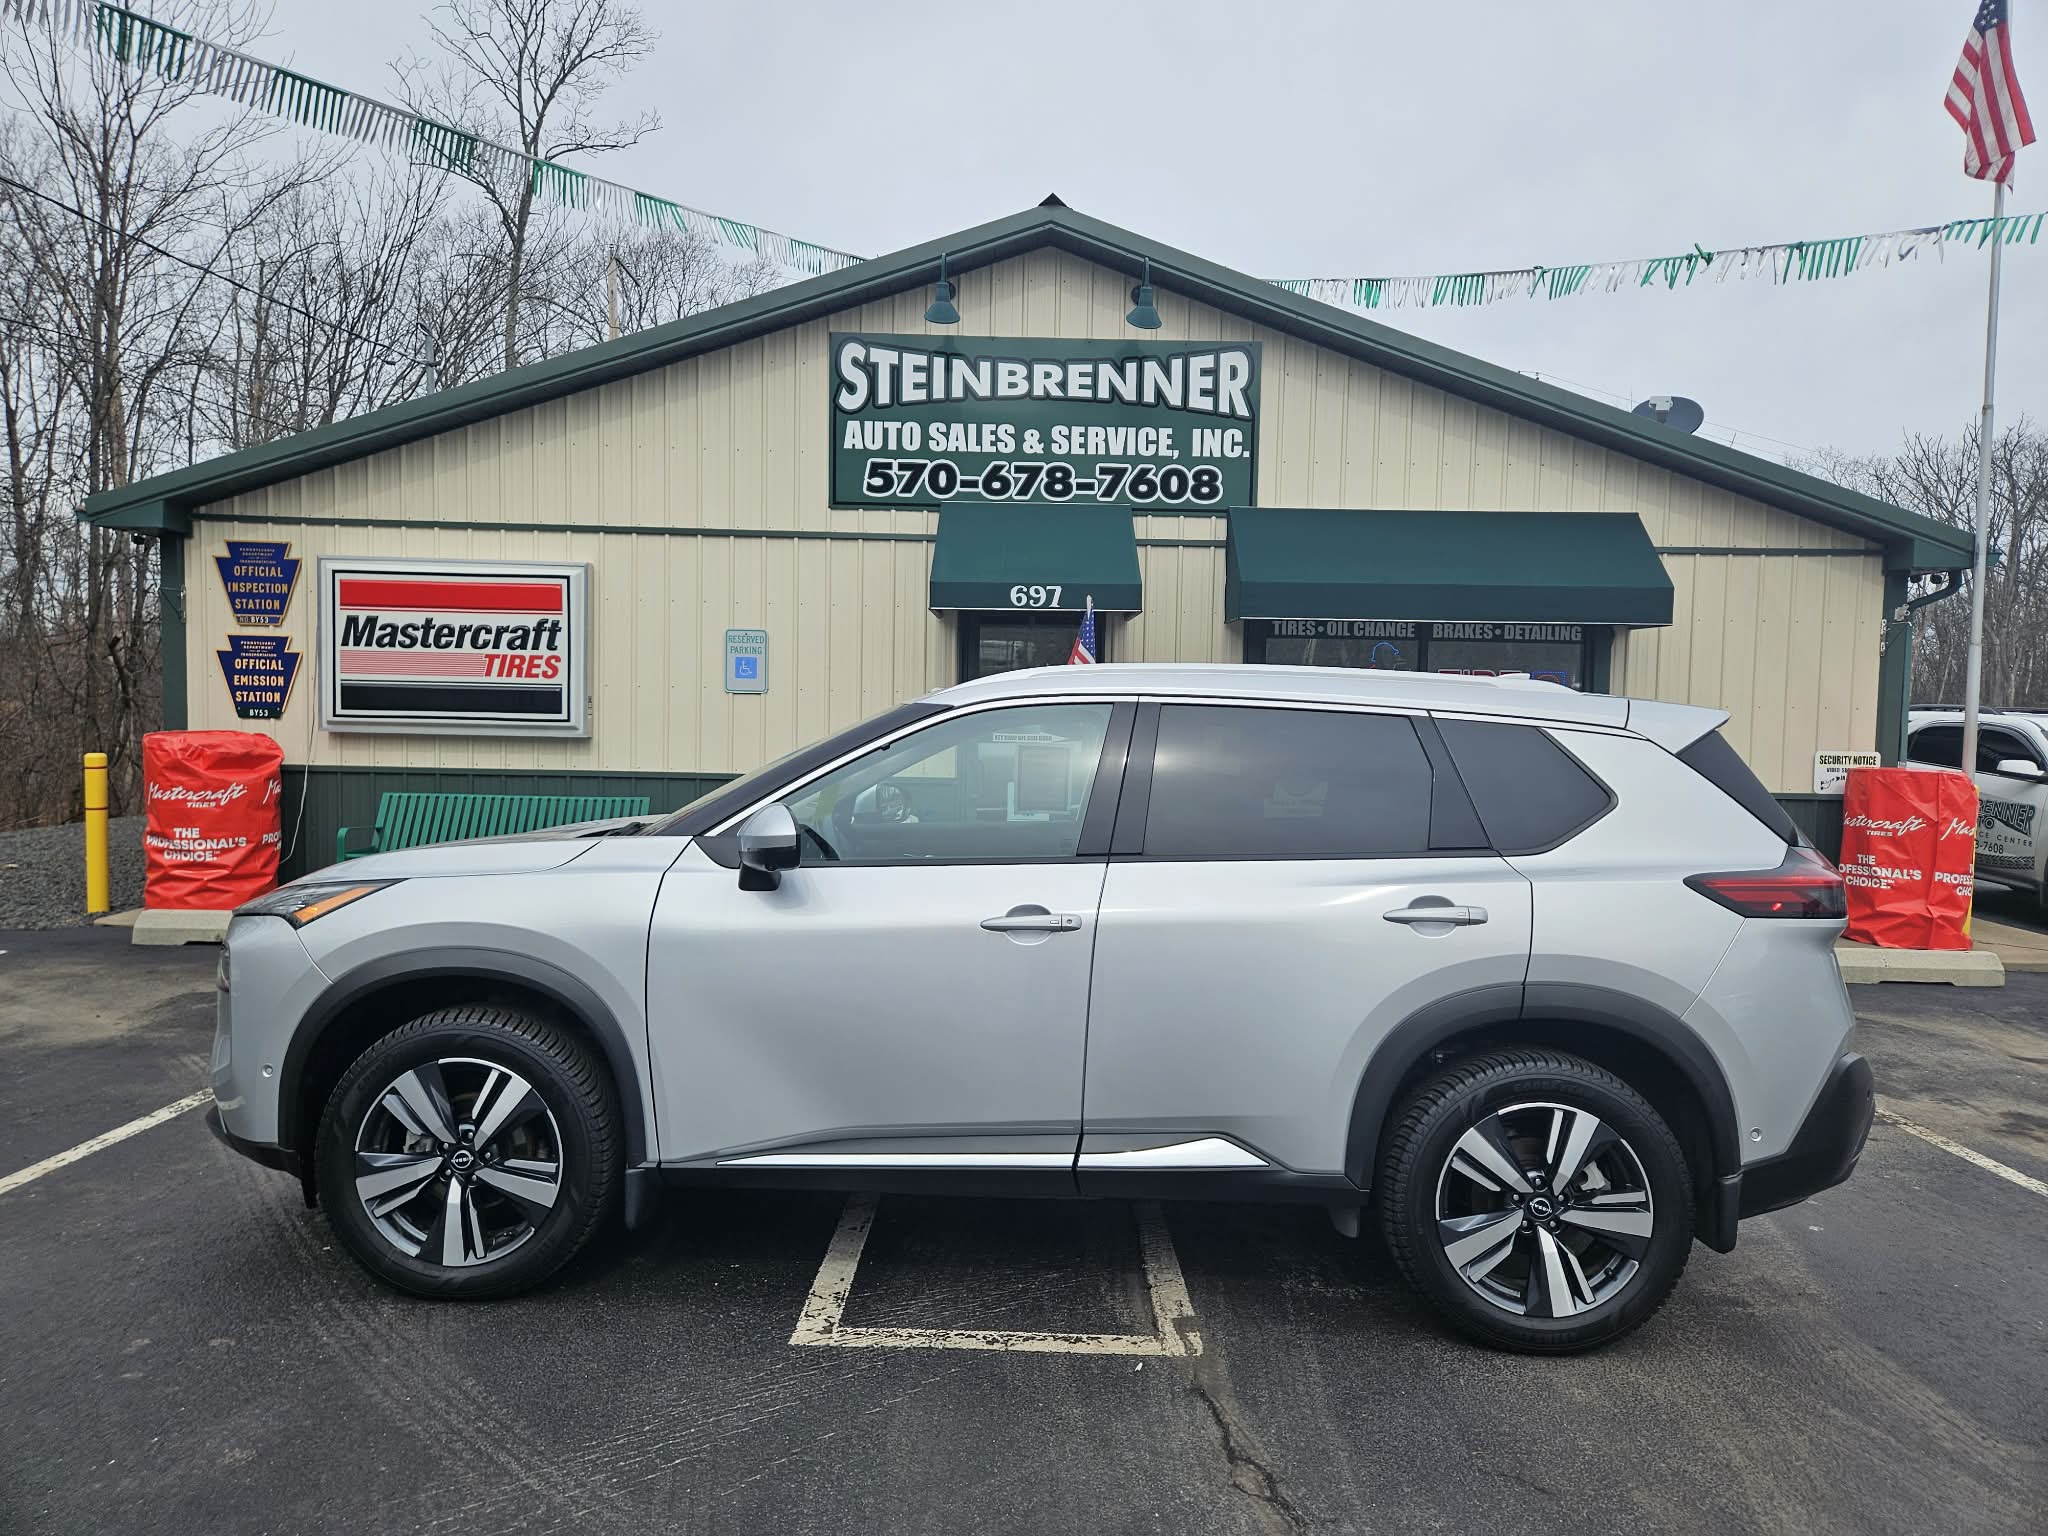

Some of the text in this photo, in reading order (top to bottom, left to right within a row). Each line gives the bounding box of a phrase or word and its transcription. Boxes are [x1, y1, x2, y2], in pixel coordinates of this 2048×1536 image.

[838, 341, 1252, 417] STEINBRENNER
[844, 420, 1251, 459] AUTO SALES & SERVICE, INC.
[863, 458, 1223, 503] 570-678-7608
[234, 565, 283, 578] OFFICIAL
[227, 582, 288, 594] INSPECTION
[1010, 584, 1063, 608] 697
[235, 598, 280, 610] STATION
[340, 614, 562, 652] Mastercraft
[1272, 620, 1416, 638] TIRES OIL CHANGE
[1432, 623, 1582, 641] BRAKES DETAILING
[728, 634, 764, 644] RESERVED
[730, 645, 762, 654] PARKING
[234, 658, 284, 670] OFFICIAL
[483, 654, 562, 679] TIRES
[233, 674, 284, 687] EMISSION
[235, 690, 280, 703] STATION
[249, 708, 269, 717] BY53
[1819, 754, 1877, 766] SECURITY NOTICE
[147, 781, 248, 806] Mastercraft
[1843, 810, 1927, 836] astercraft
[173, 827, 200, 839] THE
[1866, 829, 1893, 837] TIRES
[1997, 835, 2033, 848] CENTER
[1857, 854, 1876, 865] THE
[1838, 863, 1923, 881] OFESSIONAL'S
